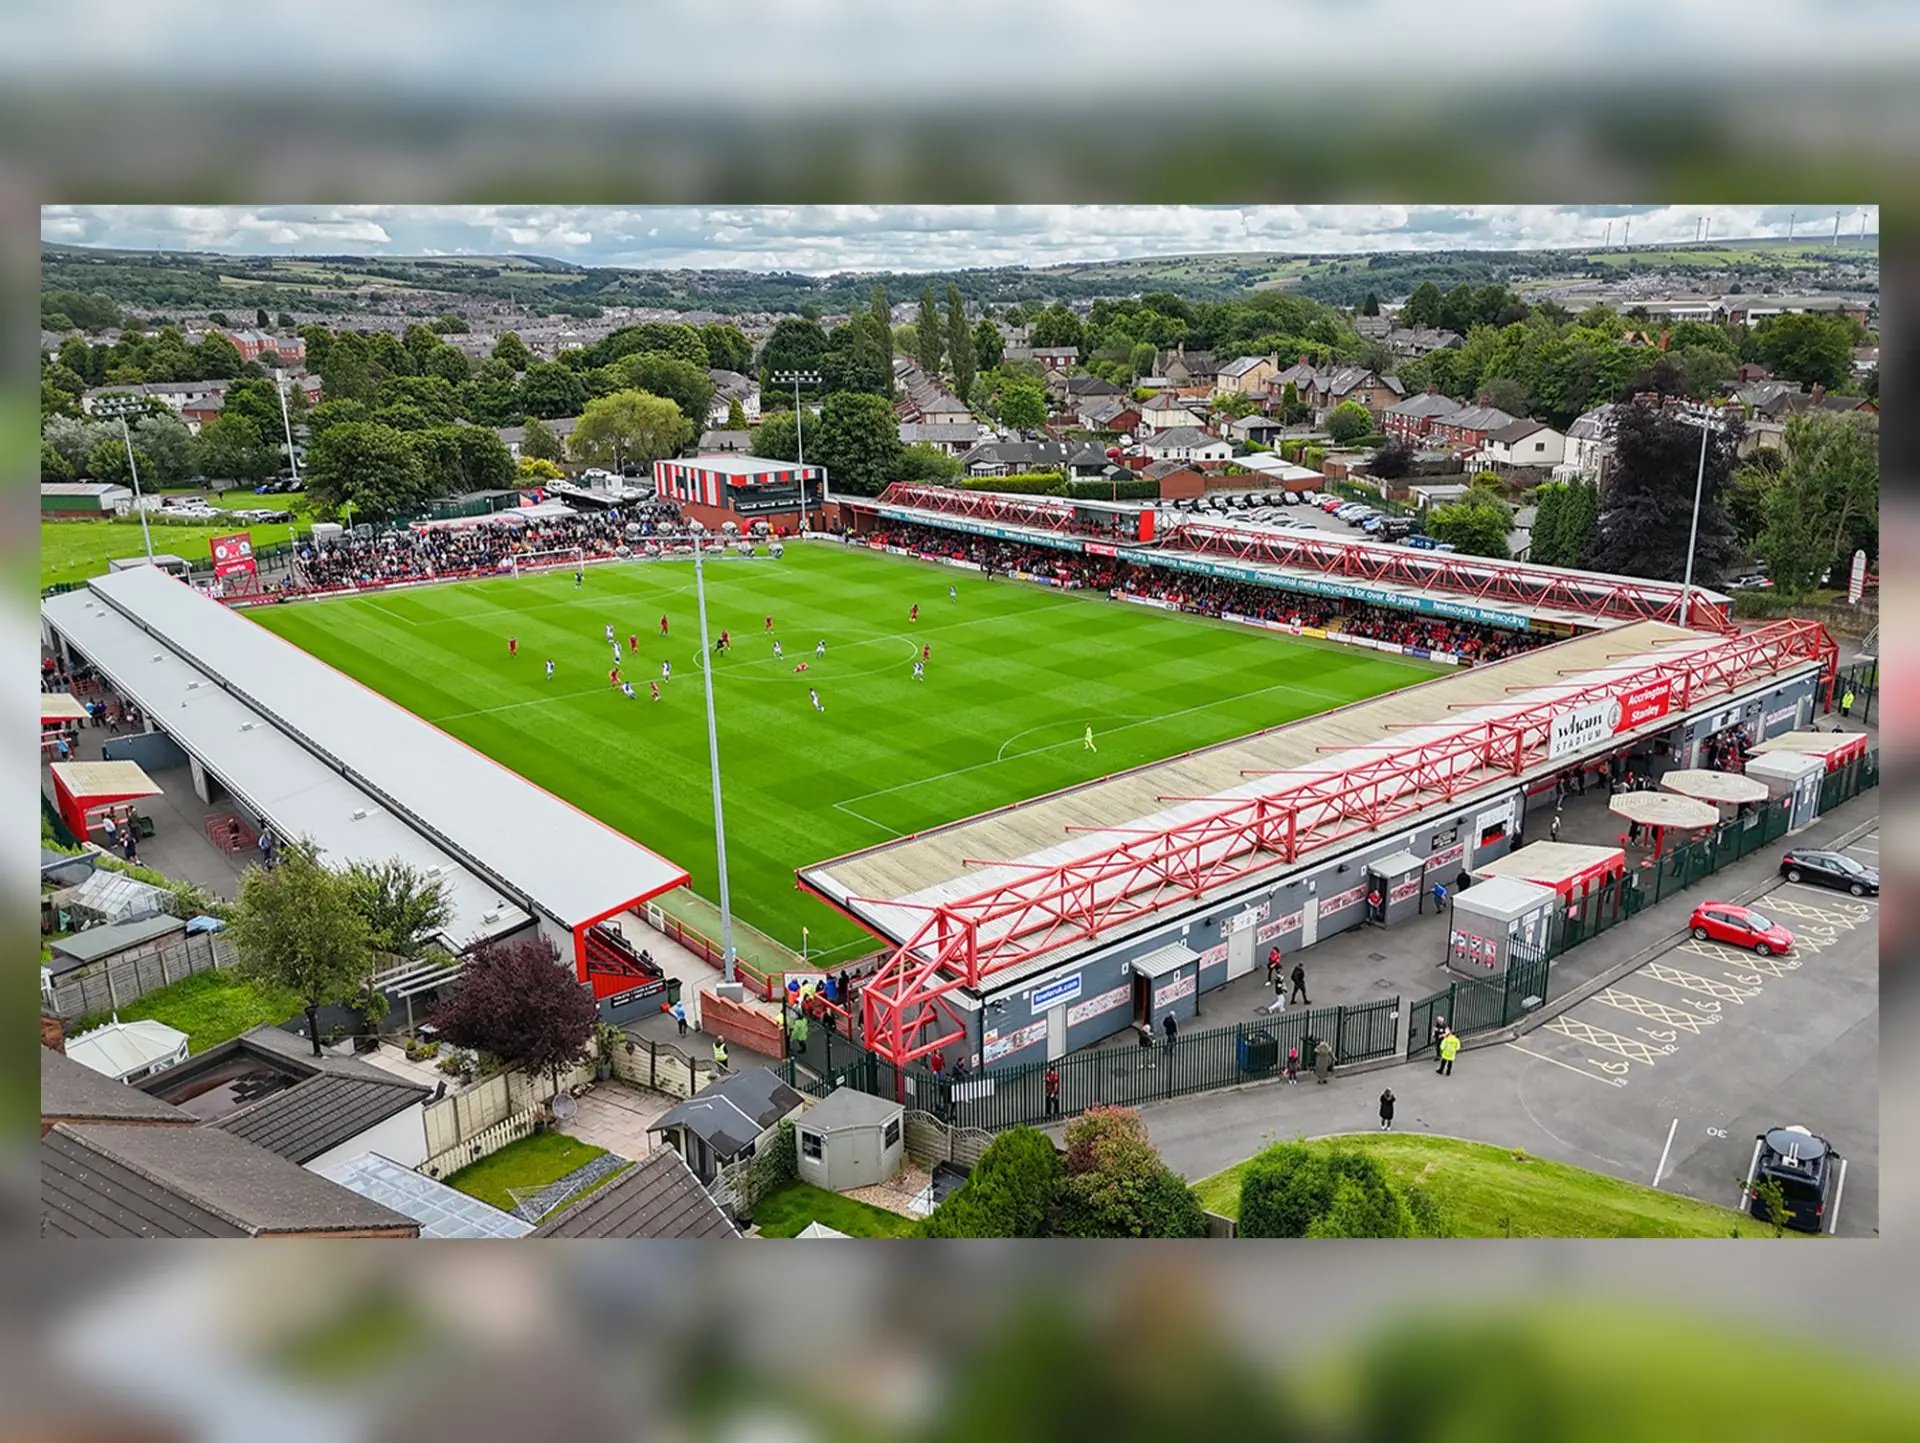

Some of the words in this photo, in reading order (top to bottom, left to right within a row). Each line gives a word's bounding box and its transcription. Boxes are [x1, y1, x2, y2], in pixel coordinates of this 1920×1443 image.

[1254, 570, 1297, 585] Professional
[1298, 578, 1318, 589] metal
[1320, 582, 1353, 597] recycling
[1354, 587, 1366, 597] for
[1366, 591, 1384, 600] over
[1385, 593, 1397, 603] 50
[1397, 597, 1420, 607] years
[1627, 684, 1669, 706] Accrington
[1630, 704, 1660, 722] Stanley
[1558, 714, 1602, 738] wham
[1555, 729, 1603, 753] STADIUM
